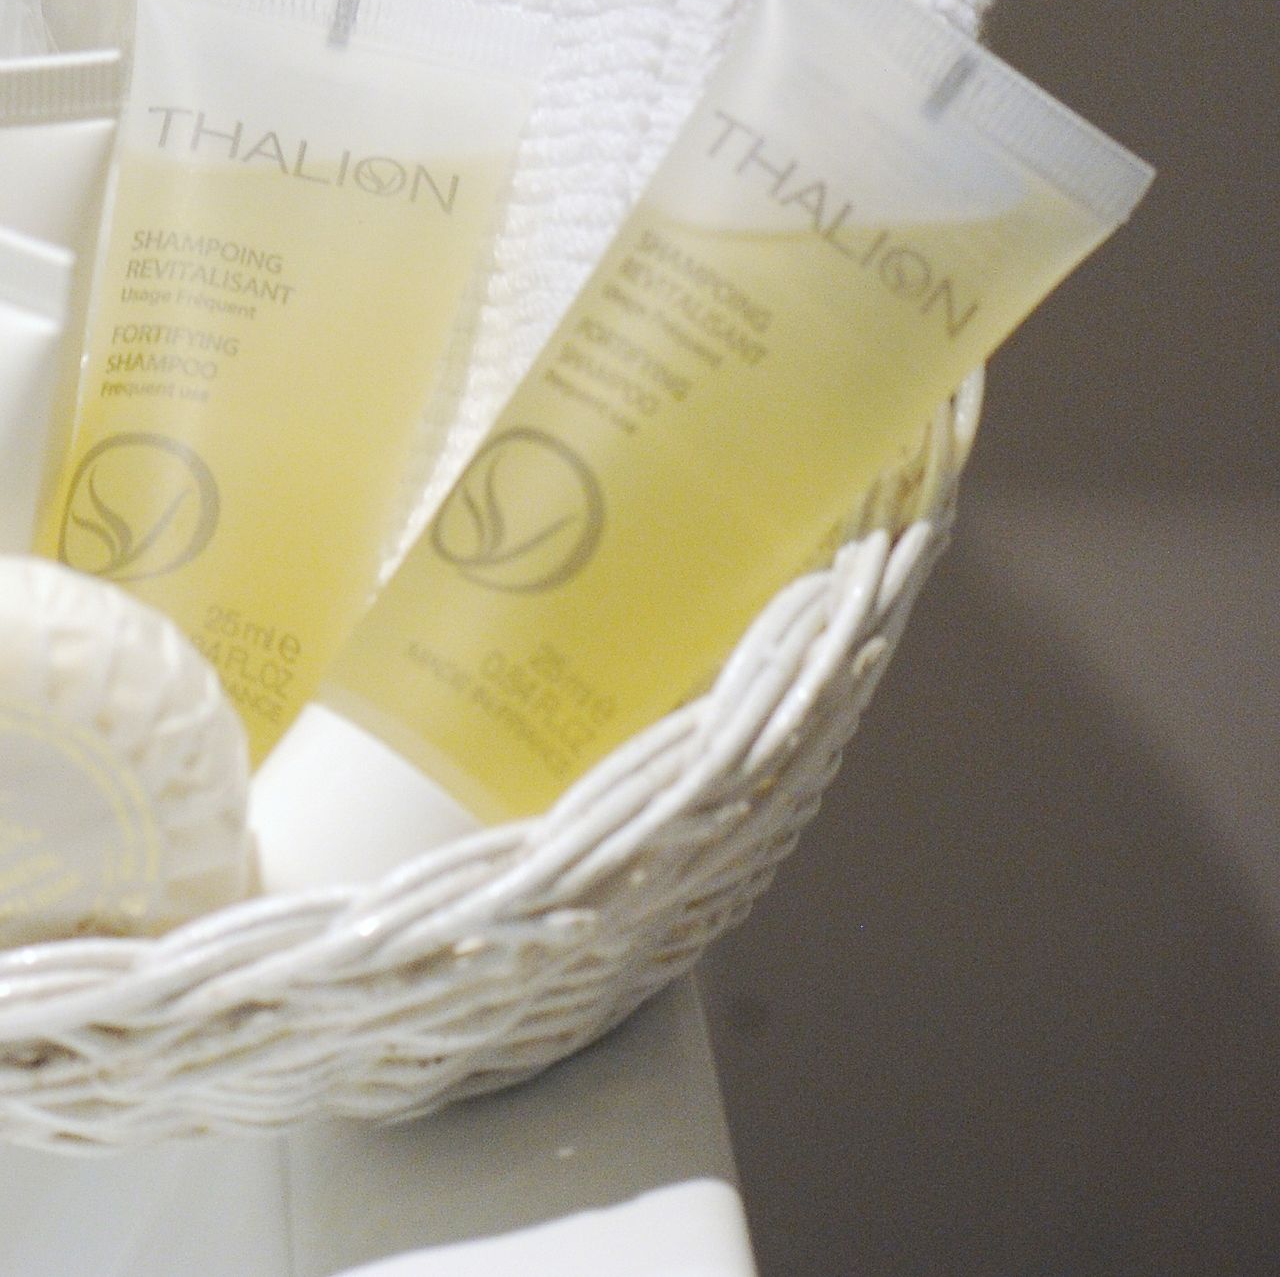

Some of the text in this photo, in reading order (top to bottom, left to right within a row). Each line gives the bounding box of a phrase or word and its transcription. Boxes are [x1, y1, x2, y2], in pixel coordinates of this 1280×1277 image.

[148, 105, 460, 215] THALION
[708, 109, 980, 339] THALION
[131, 230, 285, 275] SHAMPOING
[125, 258, 296, 306] REVITALISANT
[112, 324, 241, 358] FORTIFYING
[105, 351, 218, 380] SHAMPOO
